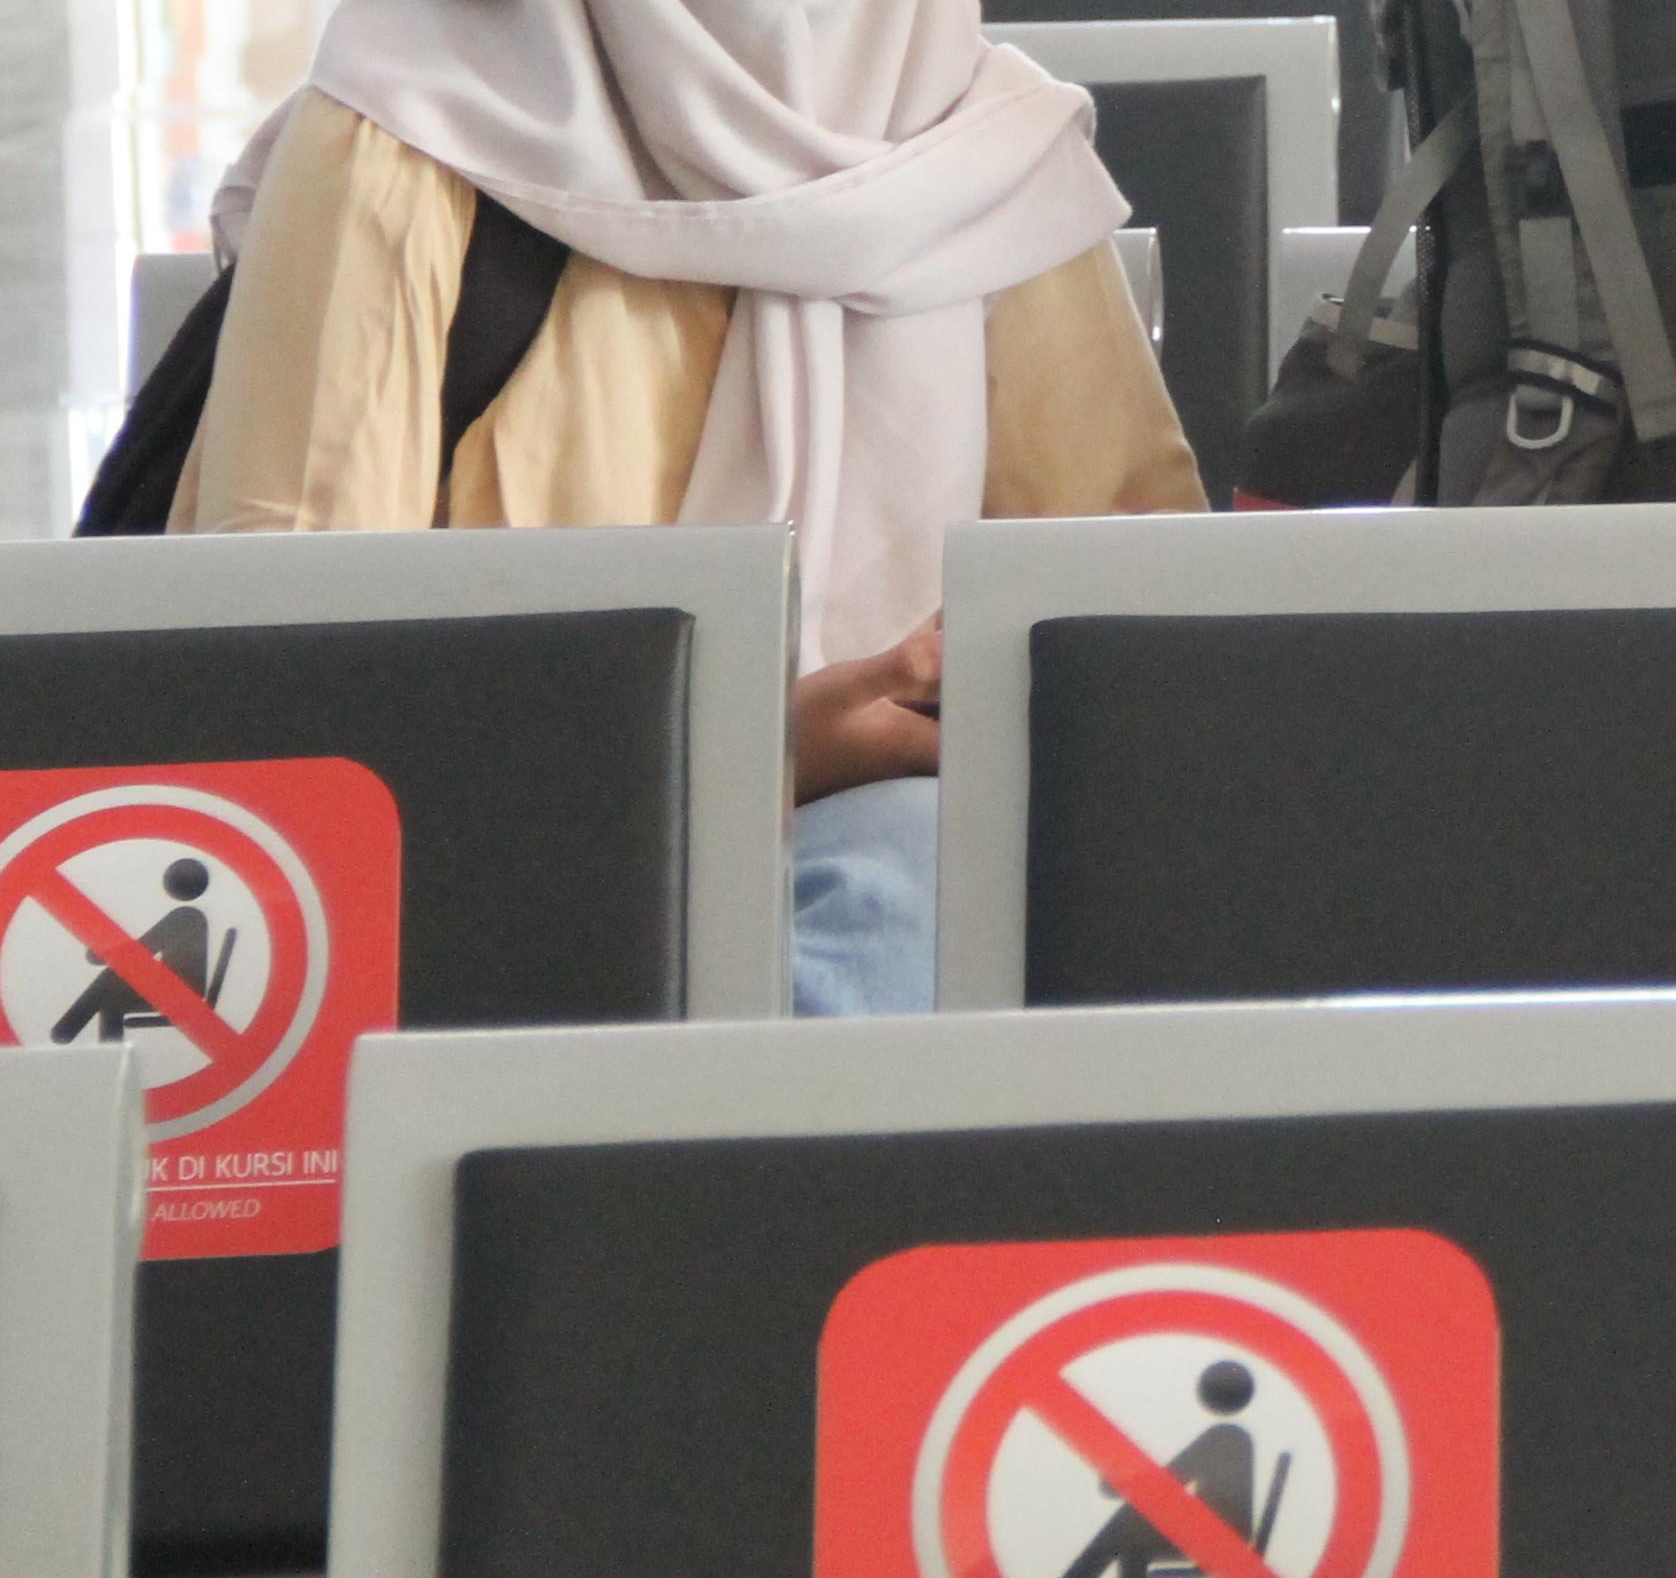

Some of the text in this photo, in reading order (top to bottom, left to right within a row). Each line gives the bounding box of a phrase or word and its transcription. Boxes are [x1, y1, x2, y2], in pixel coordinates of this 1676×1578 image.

[178, 1155, 205, 1181] DI
[215, 1151, 293, 1179] KURSI
[303, 1149, 338, 1173] INI
[152, 1198, 261, 1221] ALLOWED
